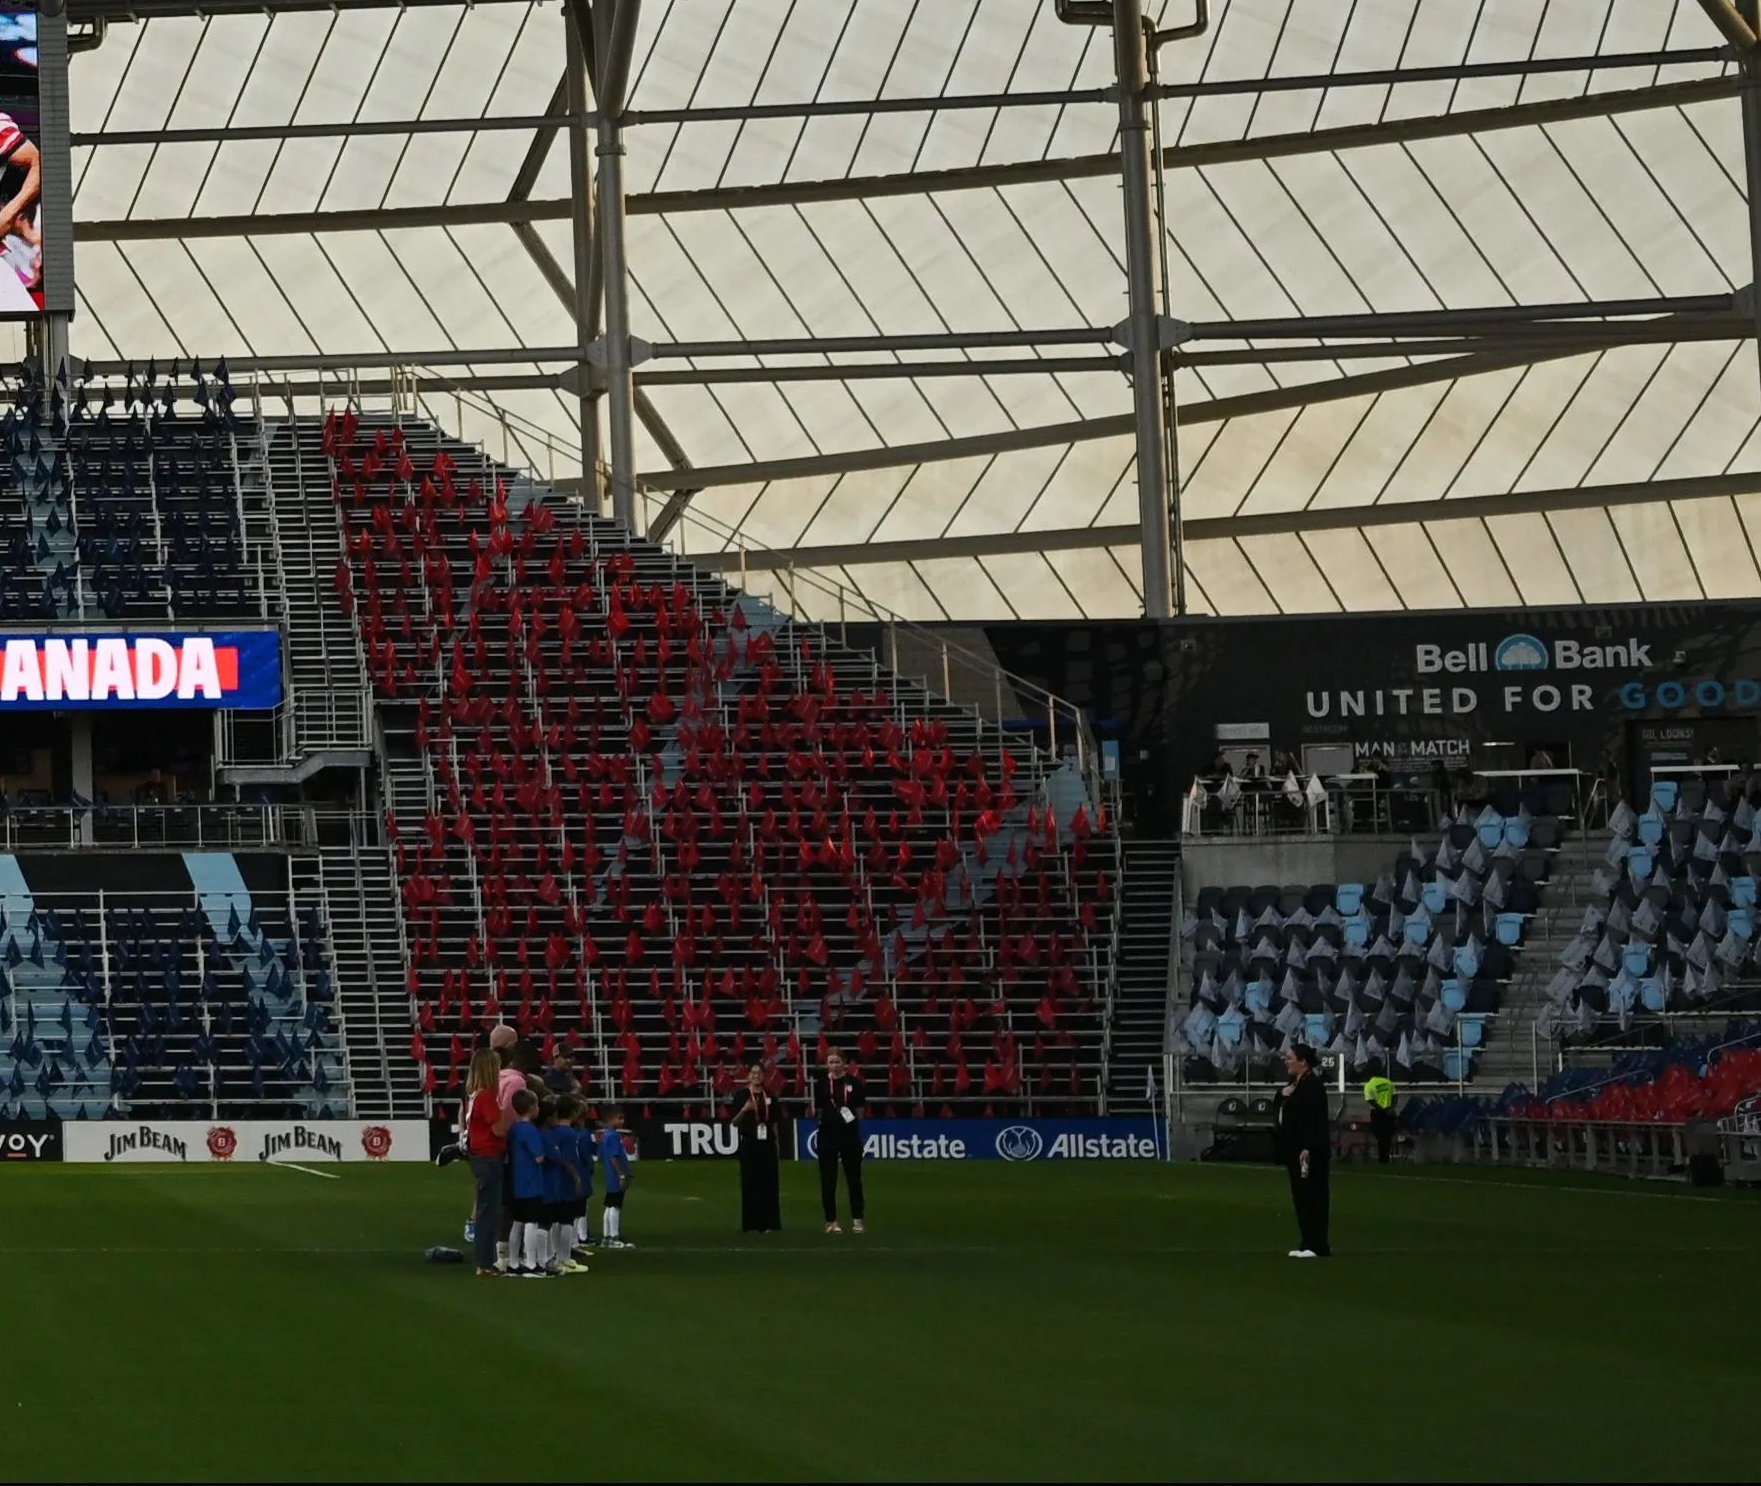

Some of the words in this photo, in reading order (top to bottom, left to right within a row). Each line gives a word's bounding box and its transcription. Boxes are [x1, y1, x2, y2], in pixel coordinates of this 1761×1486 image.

[1416, 643, 1488, 674] Bell
[1554, 638, 1653, 669] Bank
[1306, 687, 1478, 718] UNITED
[1504, 684, 1594, 713] FOR
[1618, 678, 1761, 709] GOOD
[1410, 739, 1470, 756] MATCH
[104, 1132, 137, 1161] JIM
[139, 1125, 186, 1160] BEAM
[259, 1132, 291, 1161] JIM
[293, 1125, 342, 1160] BEAM
[862, 1133, 966, 1160] Allstate
[1048, 1132, 1155, 1160] Allstate
